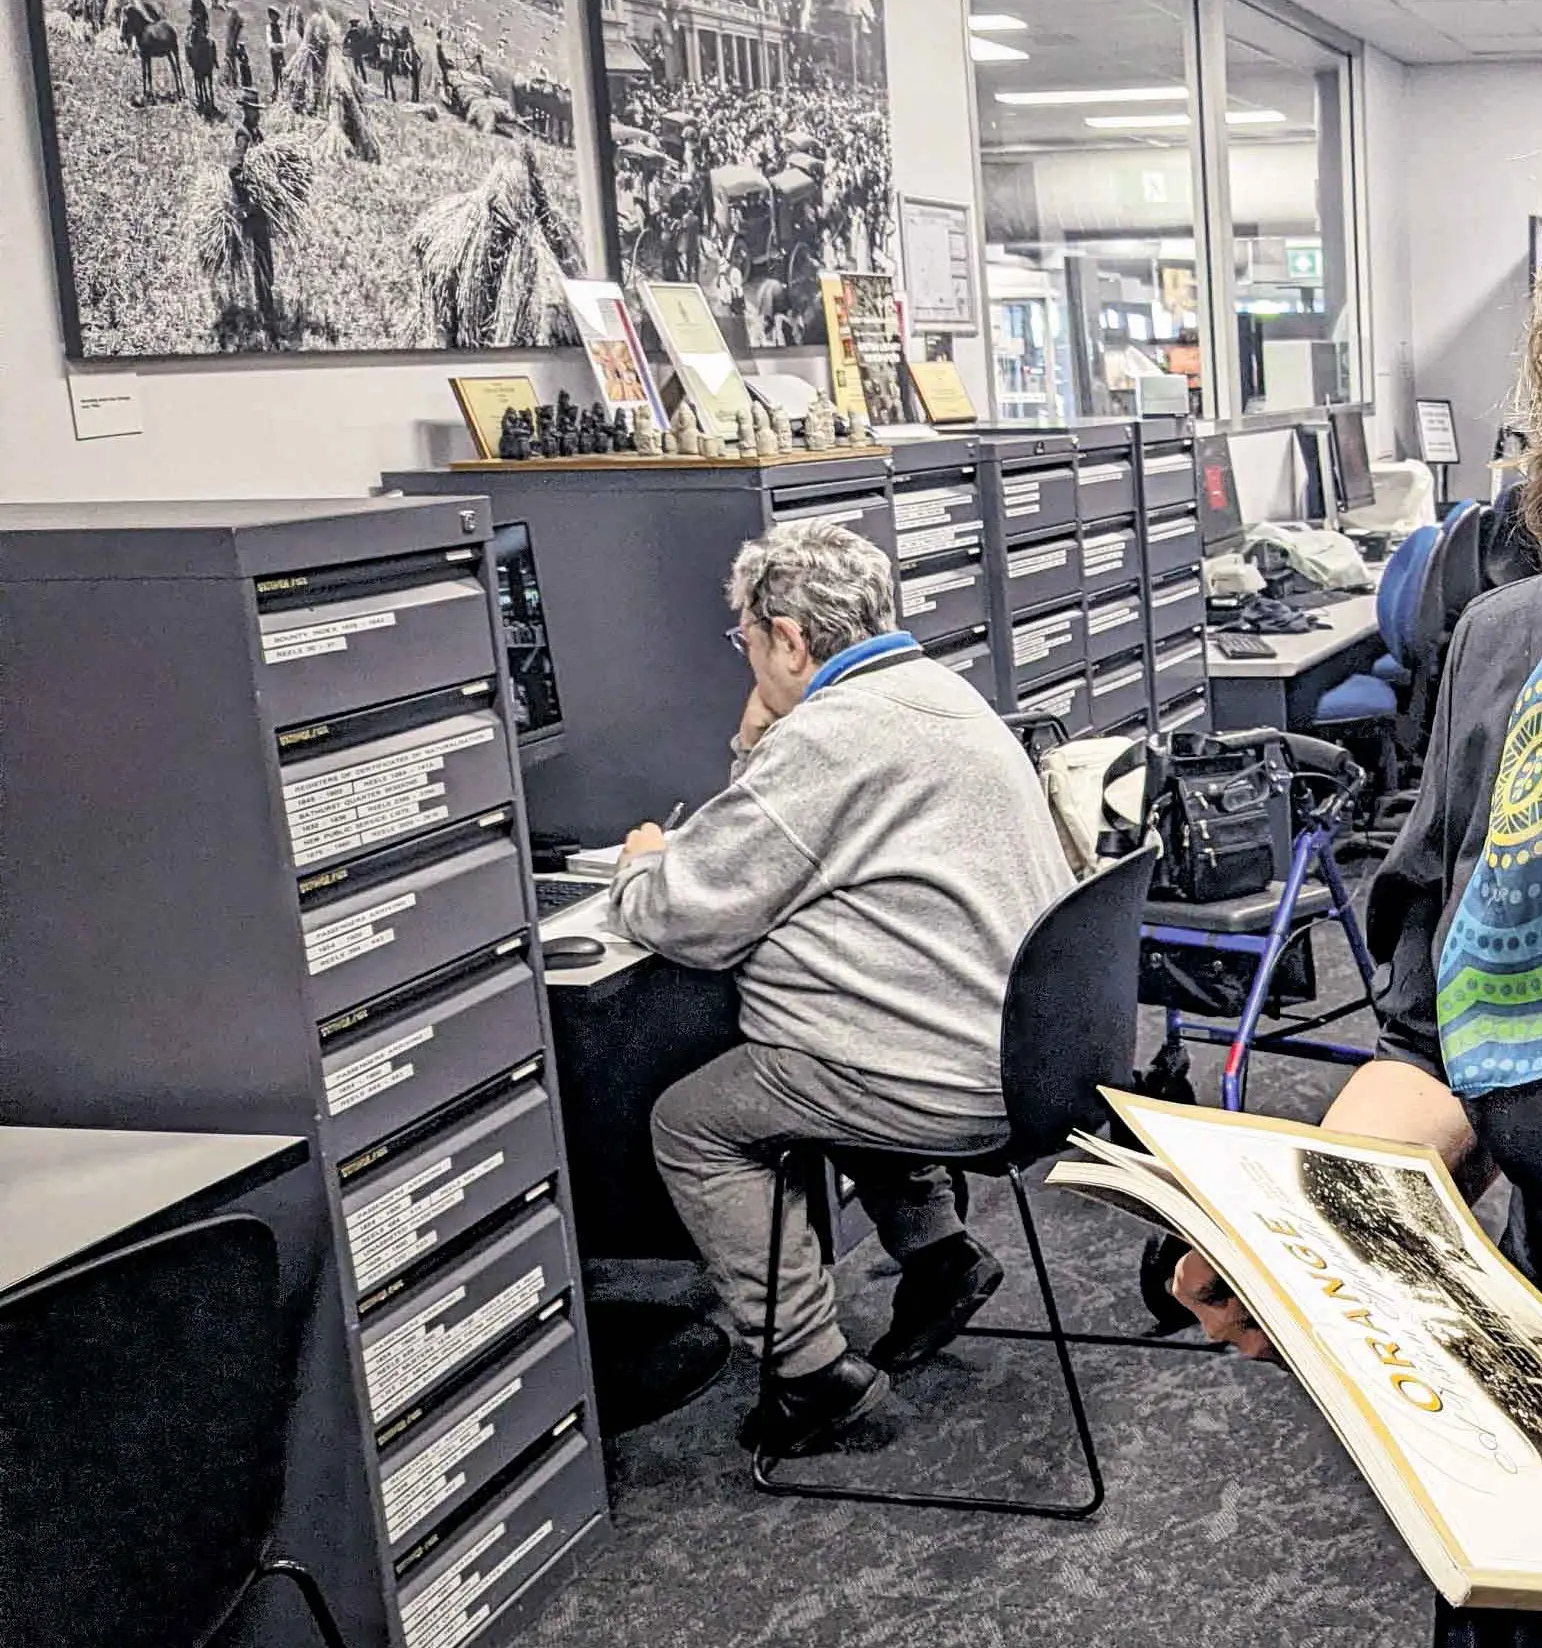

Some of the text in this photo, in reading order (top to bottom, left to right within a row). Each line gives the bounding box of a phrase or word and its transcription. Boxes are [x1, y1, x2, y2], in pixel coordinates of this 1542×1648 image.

[293, 774, 338, 793] REGISTERS
[297, 801, 341, 820] BATHURST
[343, 788, 381, 806] QUARTER
[322, 824, 353, 840] PUBLIC
[354, 813, 385, 829] SERVICE
[1252, 1210, 1444, 1413] ORANGE
